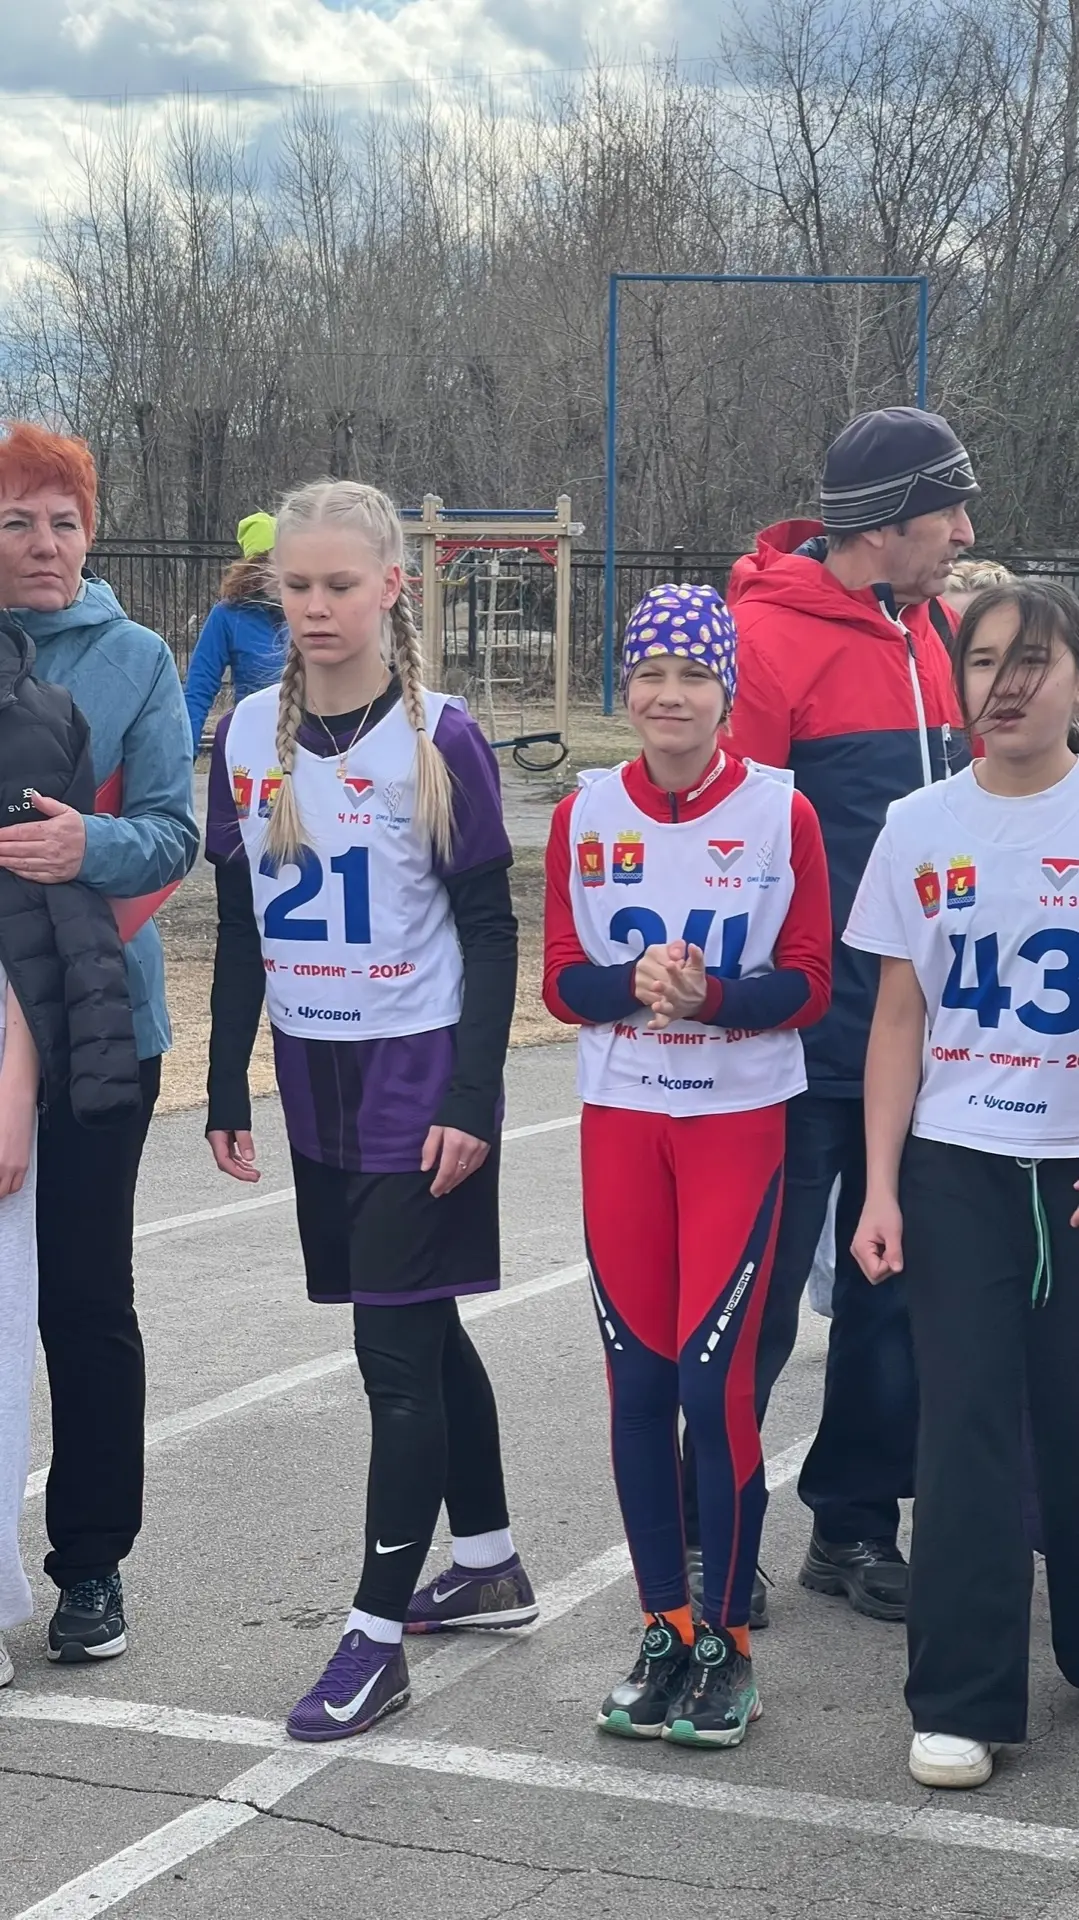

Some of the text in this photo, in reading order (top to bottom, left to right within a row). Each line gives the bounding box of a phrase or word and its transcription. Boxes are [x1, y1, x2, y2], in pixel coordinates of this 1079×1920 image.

[258, 842, 372, 945] 21
[940, 927, 1079, 1036] 43
[297, 1006, 362, 1022] Чусовой
[657, 1074, 714, 1091] Чсовой
[967, 1094, 1048, 1115] г. Чусовой
